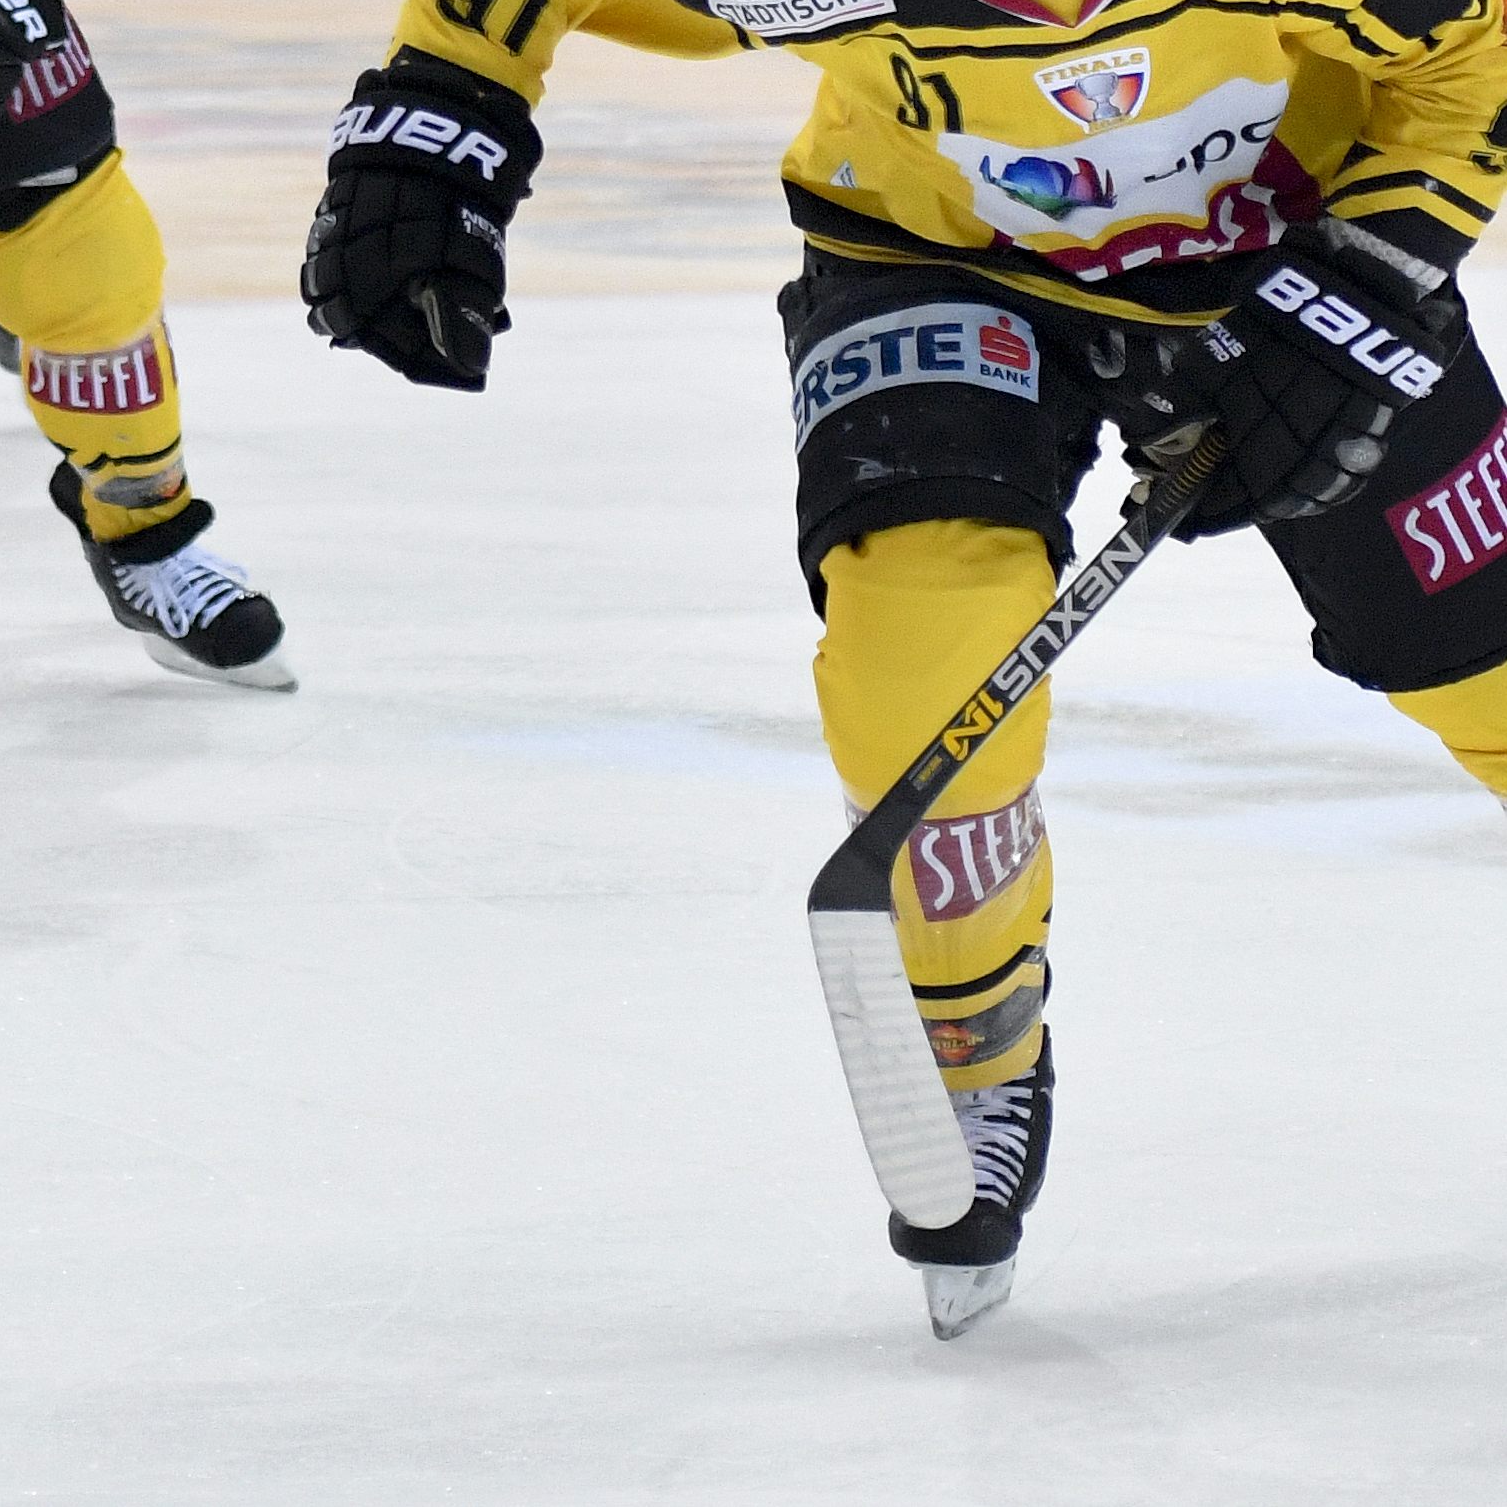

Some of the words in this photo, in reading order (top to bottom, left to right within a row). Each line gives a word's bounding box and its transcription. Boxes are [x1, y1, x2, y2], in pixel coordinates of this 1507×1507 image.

[1039, 52, 1145, 85] FINALS
[30, 347, 157, 410] STEFFL
[979, 363, 1032, 389] BANK
[991, 529, 1146, 703] NEXUS
